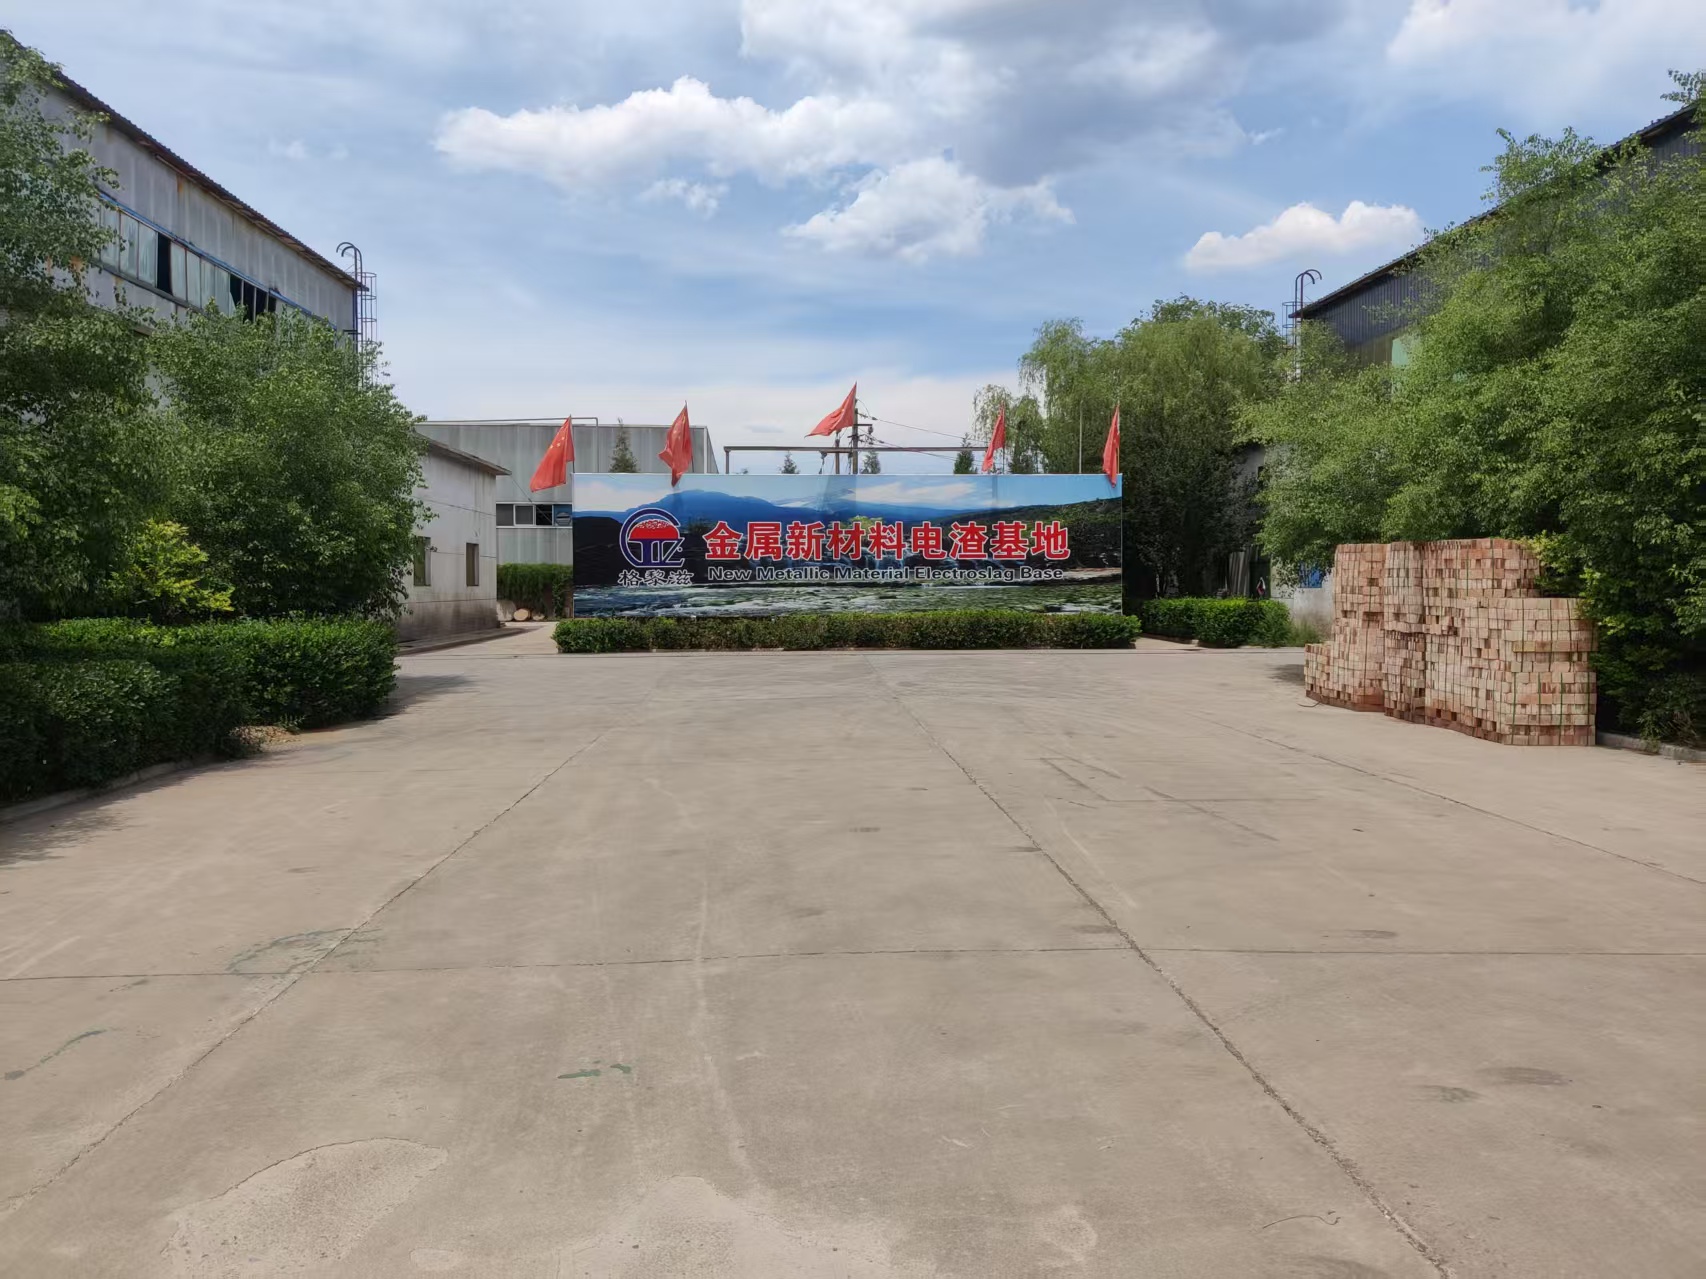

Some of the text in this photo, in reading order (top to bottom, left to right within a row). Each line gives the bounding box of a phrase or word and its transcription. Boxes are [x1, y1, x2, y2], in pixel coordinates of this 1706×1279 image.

[702, 521, 1071, 561] 金属新材料电渣基地
[708, 565, 1063, 581] New Metallic Material Electroslag Base
